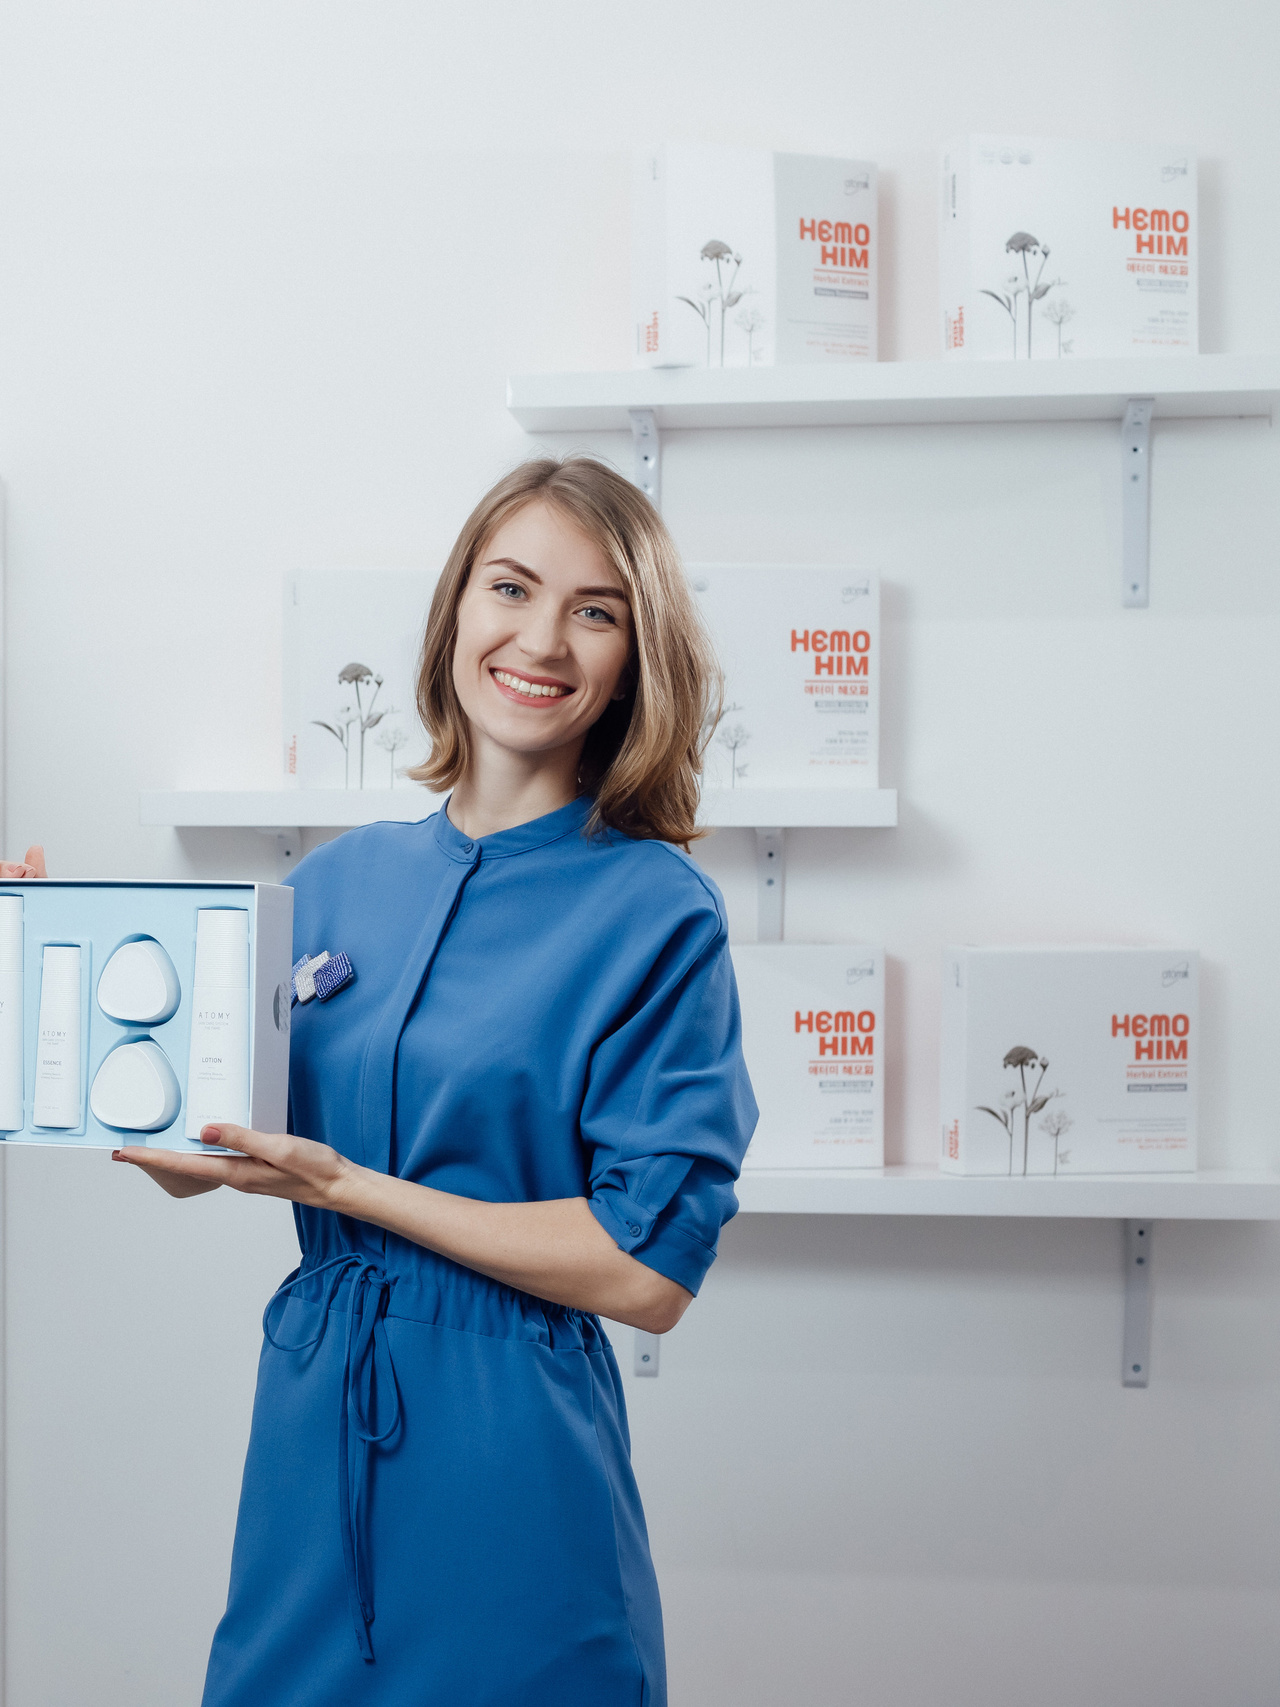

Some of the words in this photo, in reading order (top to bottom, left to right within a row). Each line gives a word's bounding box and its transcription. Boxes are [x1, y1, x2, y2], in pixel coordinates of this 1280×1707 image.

[1113, 206, 1189, 233] HEMO
[799, 217, 870, 247] HEMO
[1136, 233, 1188, 256] HIM
[821, 245, 869, 269] HIM
[791, 629, 871, 653] HEMO
[815, 655, 869, 676] HIM
[198, 1011, 230, 1020] ATOMY
[795, 1010, 876, 1033] HEMO
[1111, 1013, 1190, 1038] HEMO
[819, 1035, 873, 1056] HIM
[1135, 1039, 1188, 1060] HIM
[1126, 1070, 1156, 1079] Herbal
[1157, 1070, 1188, 1079] Extract
